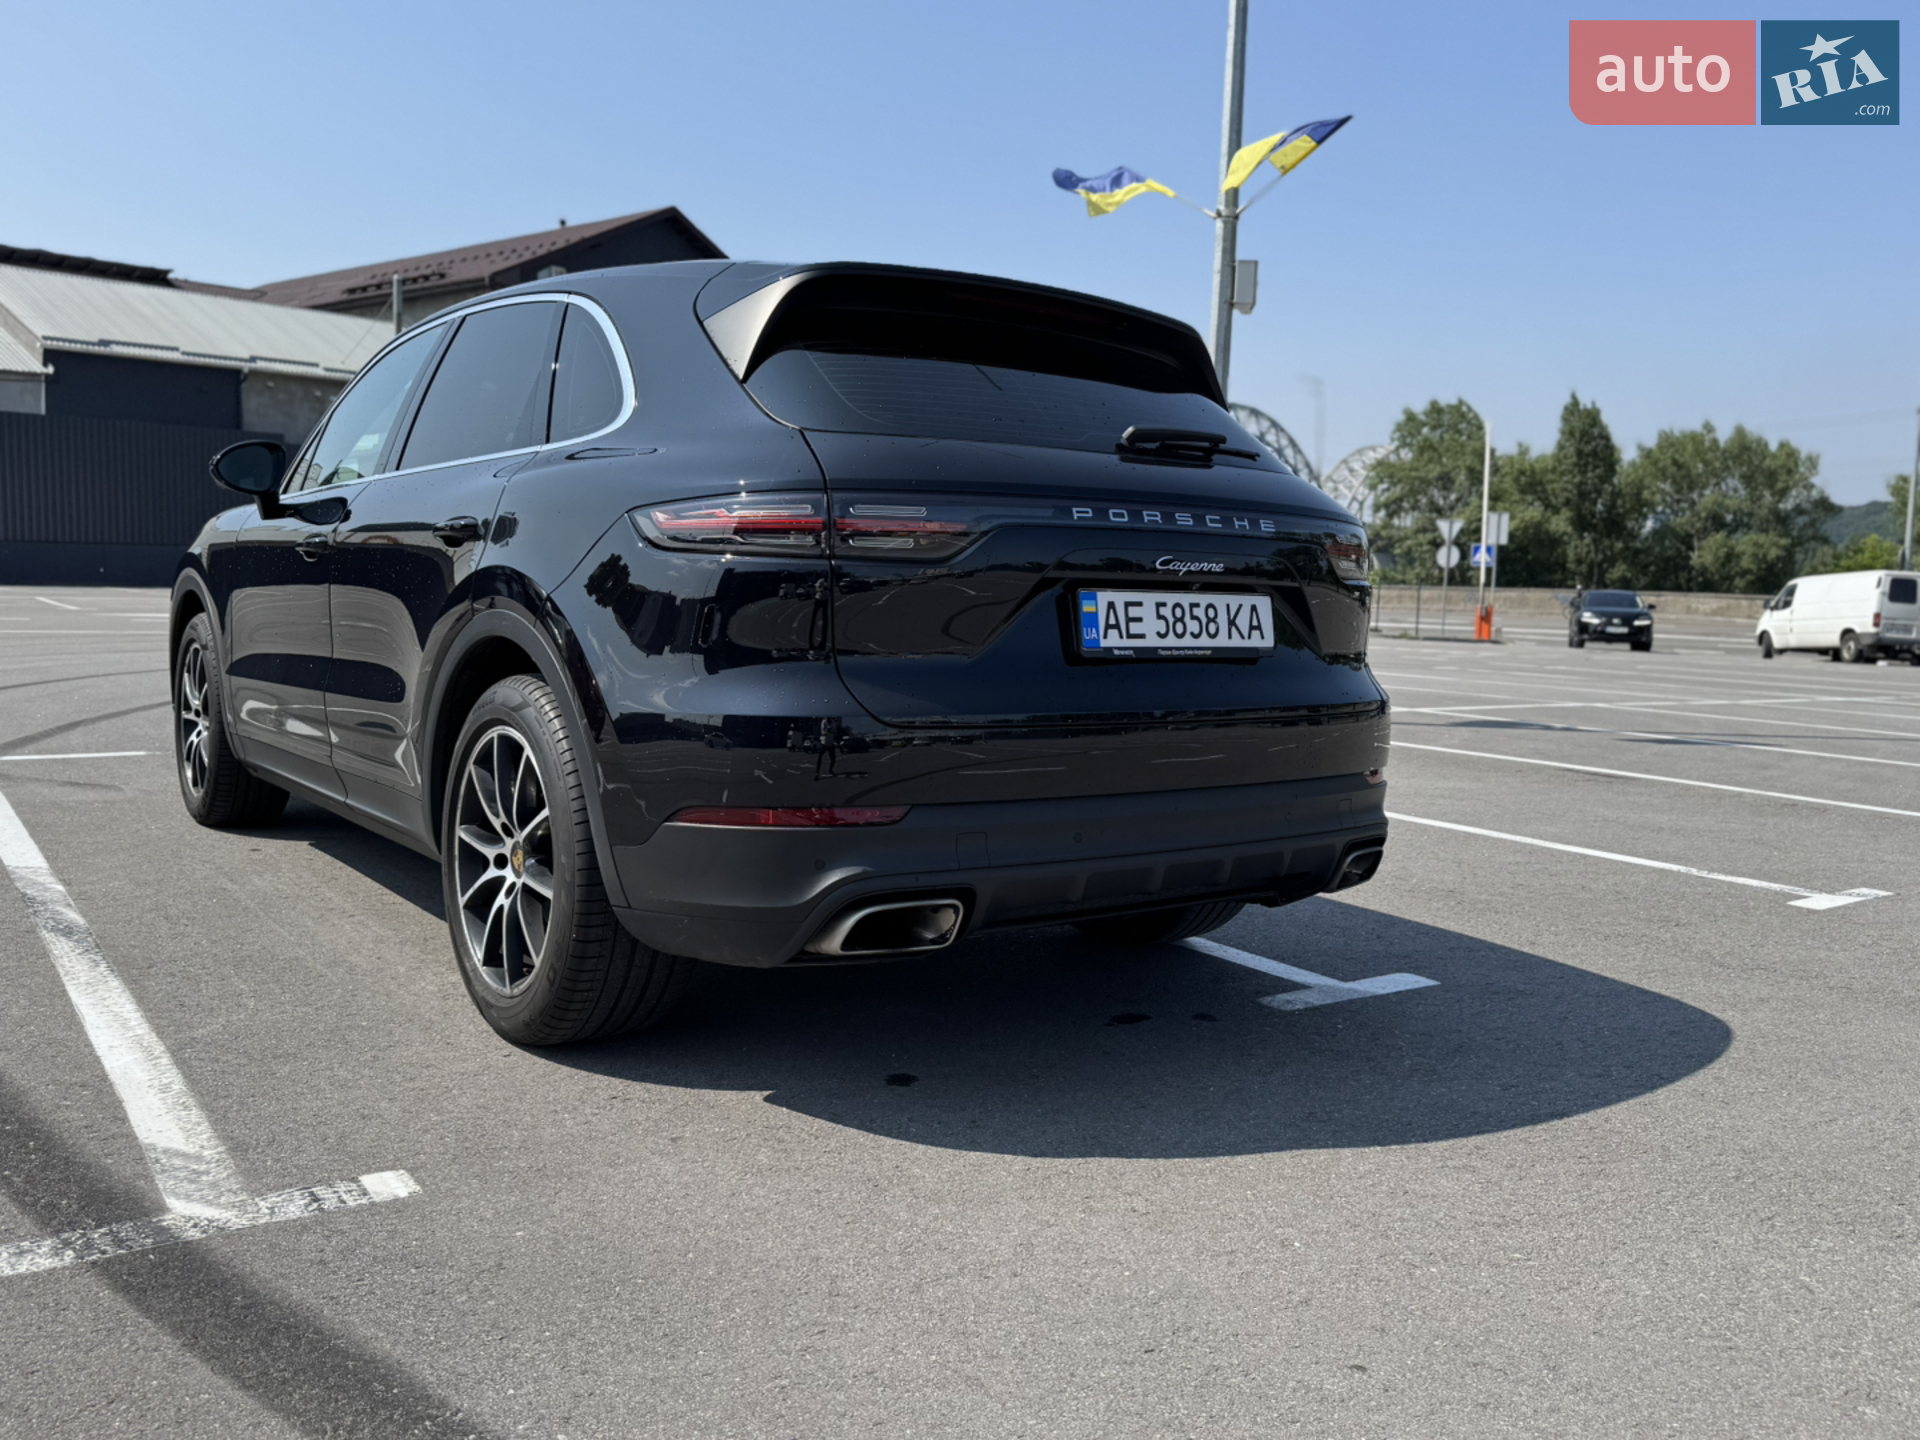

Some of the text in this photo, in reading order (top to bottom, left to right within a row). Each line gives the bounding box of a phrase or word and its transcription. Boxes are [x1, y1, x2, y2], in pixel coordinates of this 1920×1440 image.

[1072, 507, 1276, 532] PORSCHE
[1155, 556, 1225, 577] Cayenne
[1103, 600, 1265, 640] AE 5858 KA
[1083, 627, 1099, 640] UA
